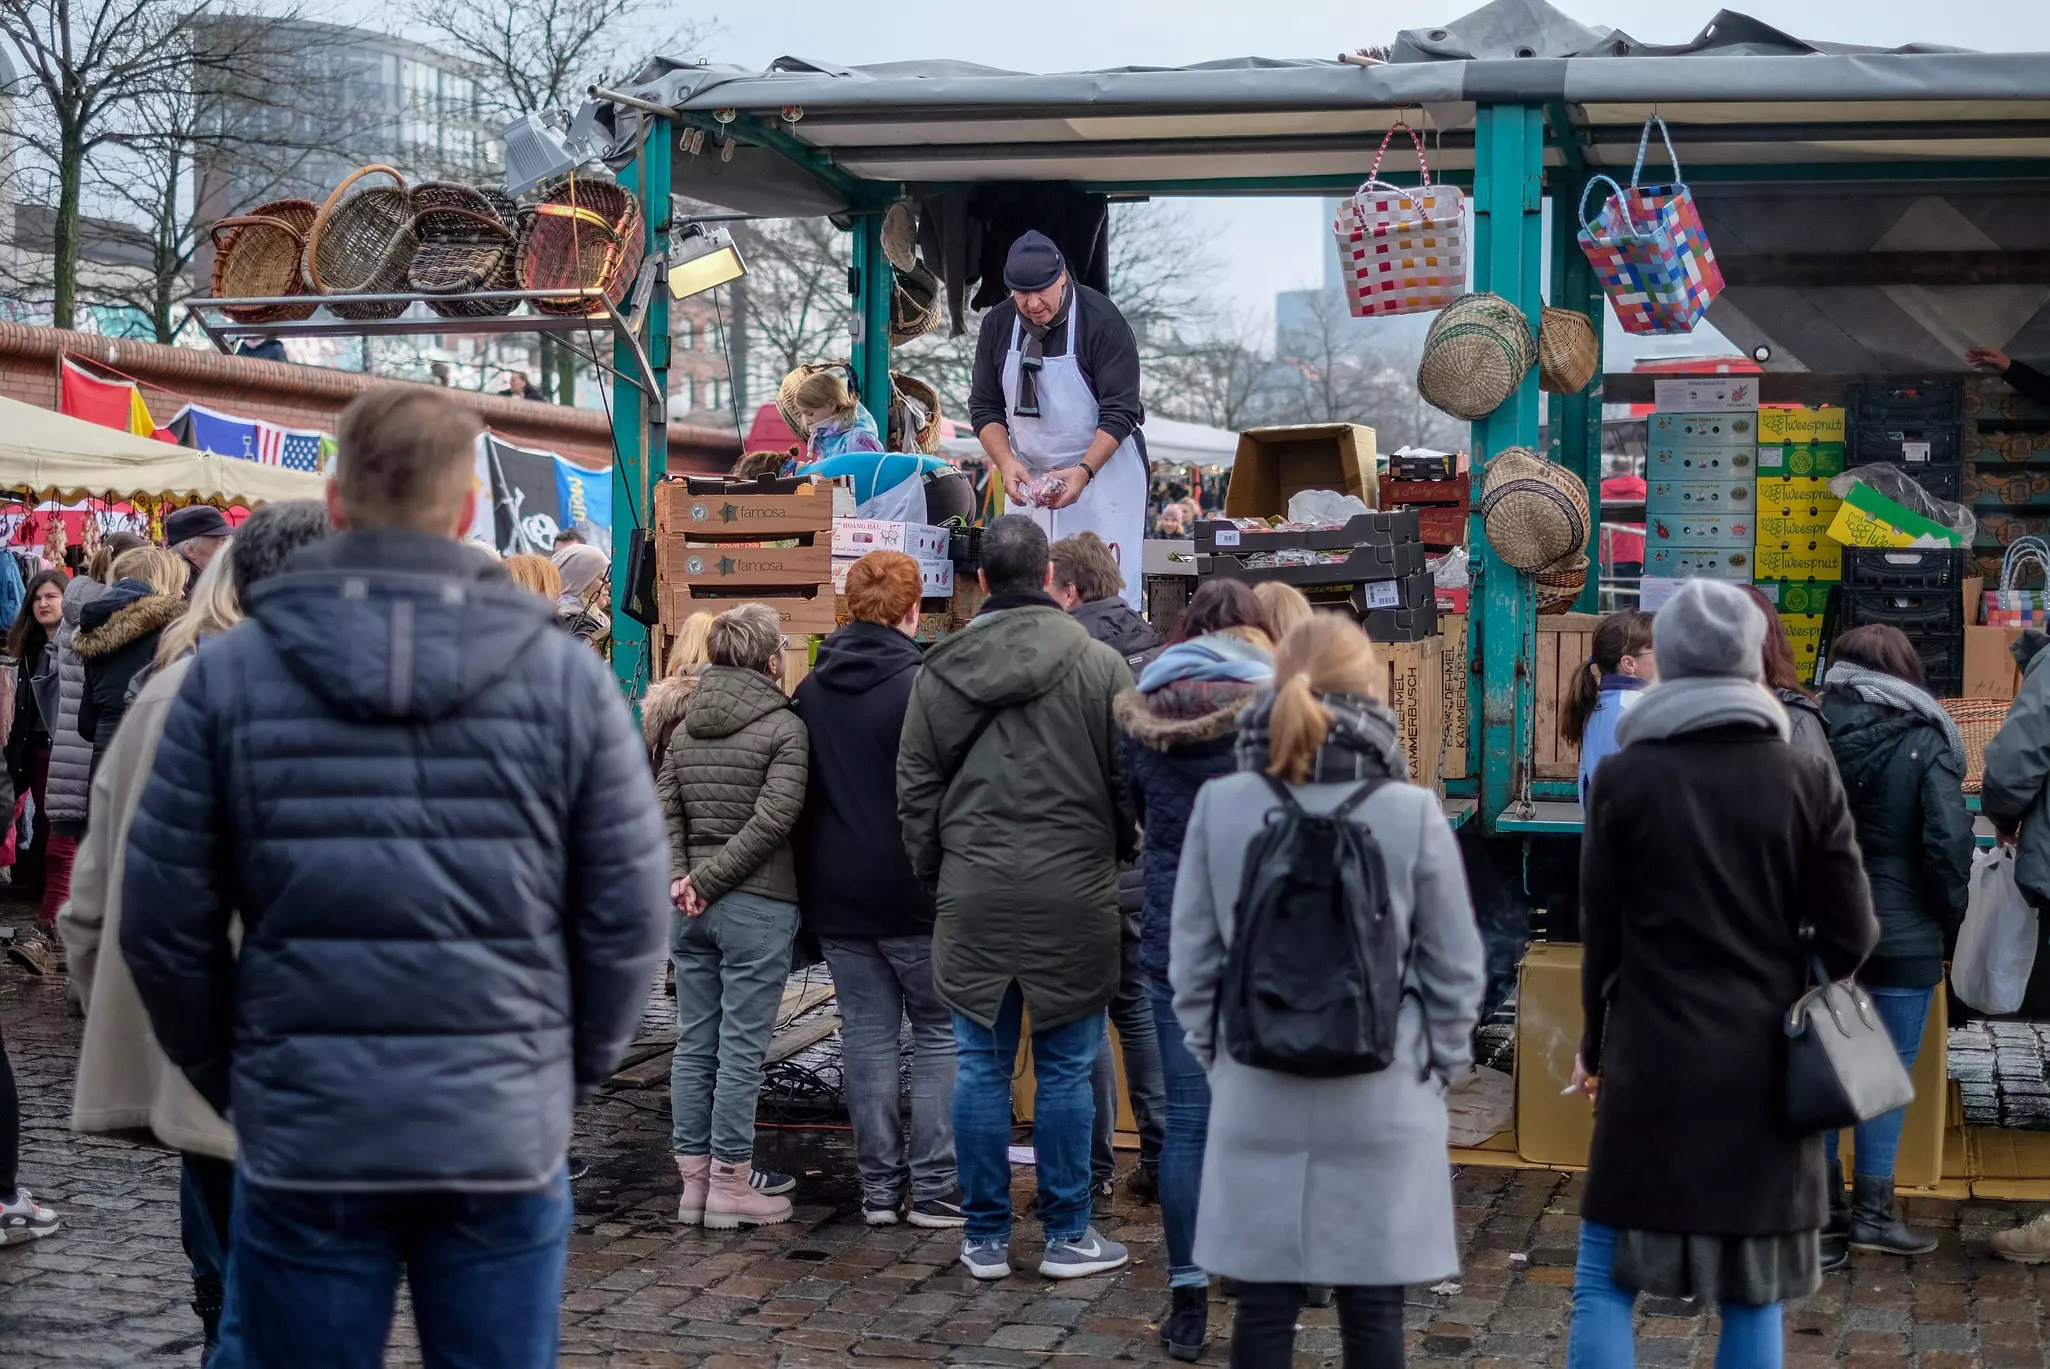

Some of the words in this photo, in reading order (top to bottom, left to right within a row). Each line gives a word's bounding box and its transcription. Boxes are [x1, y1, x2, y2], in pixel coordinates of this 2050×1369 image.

[1775, 414, 1843, 435] Tweespruit
[740, 505, 786, 519] famosa
[1774, 517, 1828, 538] Tweespr
[738, 559, 783, 572] famosa
[1772, 551, 1839, 573] Tweespruit
[1444, 645, 1455, 700] DEHMEL
[1407, 667, 1419, 779] KAMMERBUSCH
